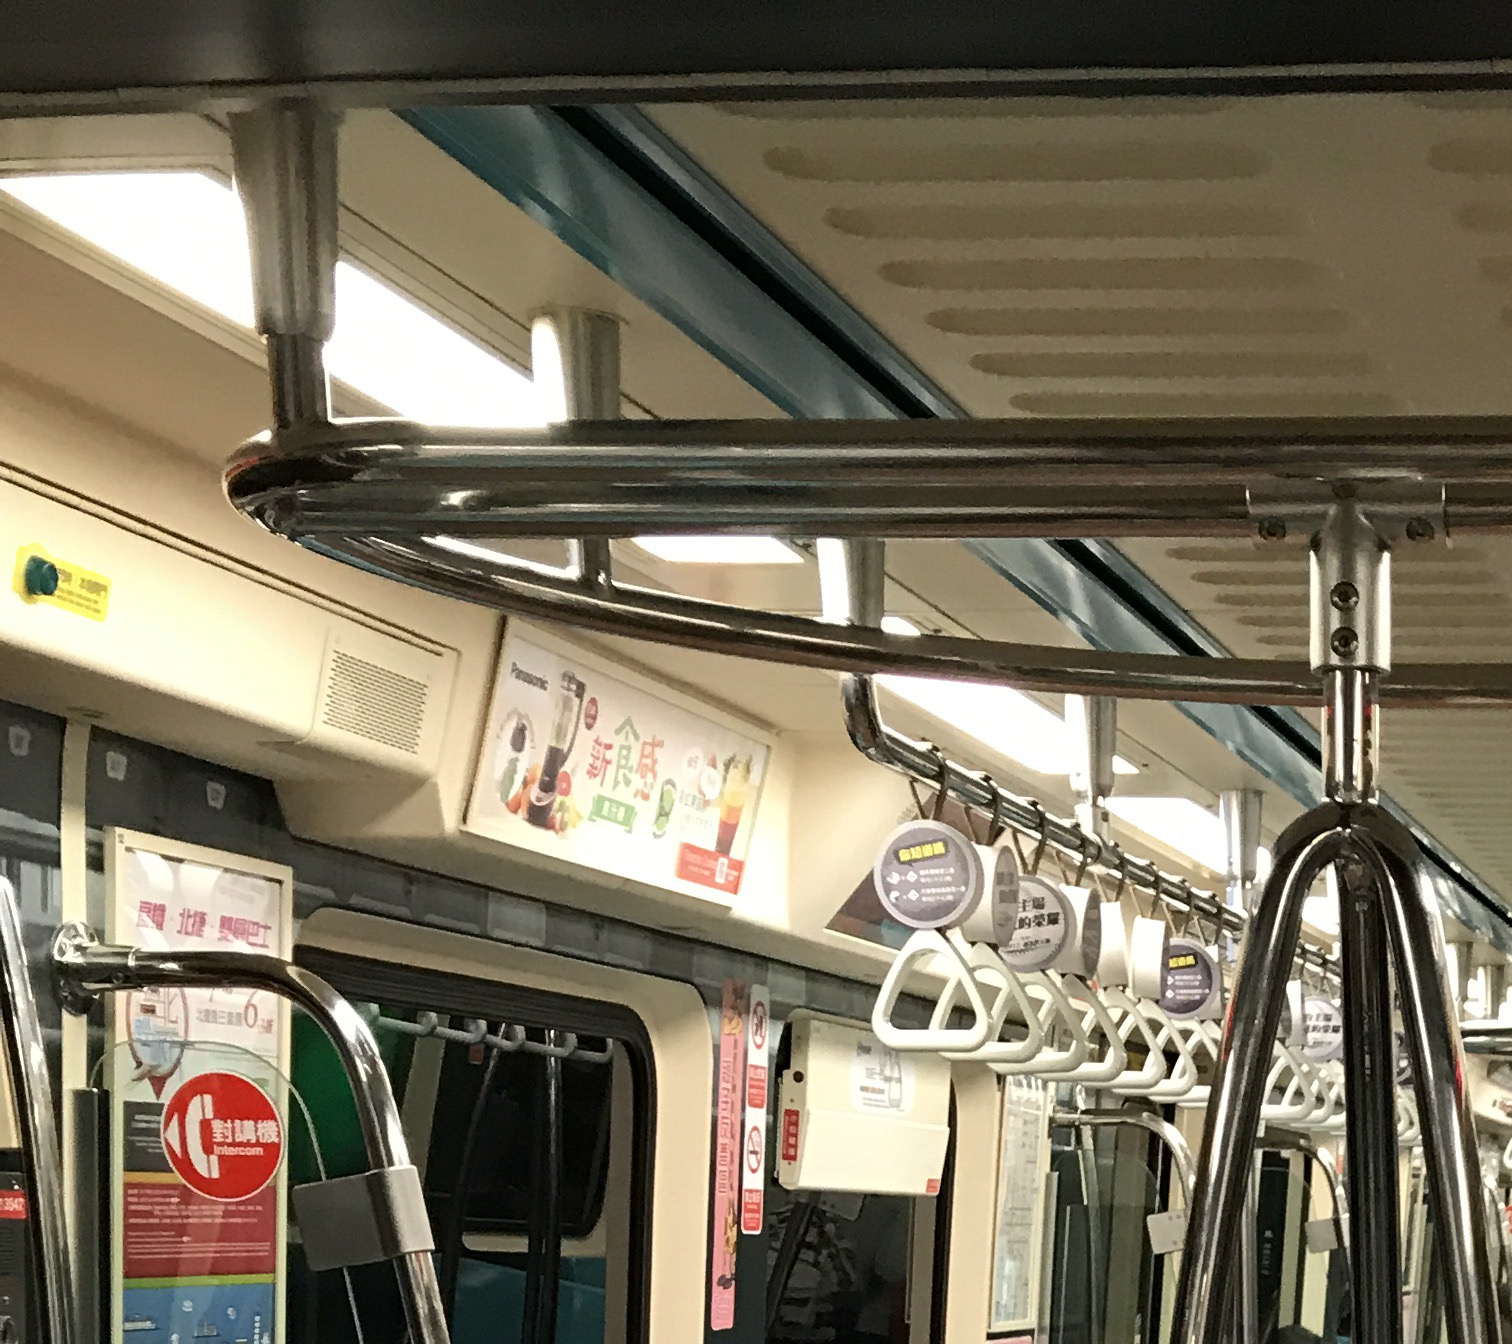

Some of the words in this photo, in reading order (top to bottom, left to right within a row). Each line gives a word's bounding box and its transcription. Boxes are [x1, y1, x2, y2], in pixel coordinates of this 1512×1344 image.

[210, 1119, 280, 1144] 對講機
[213, 1145, 264, 1156] Intercom
